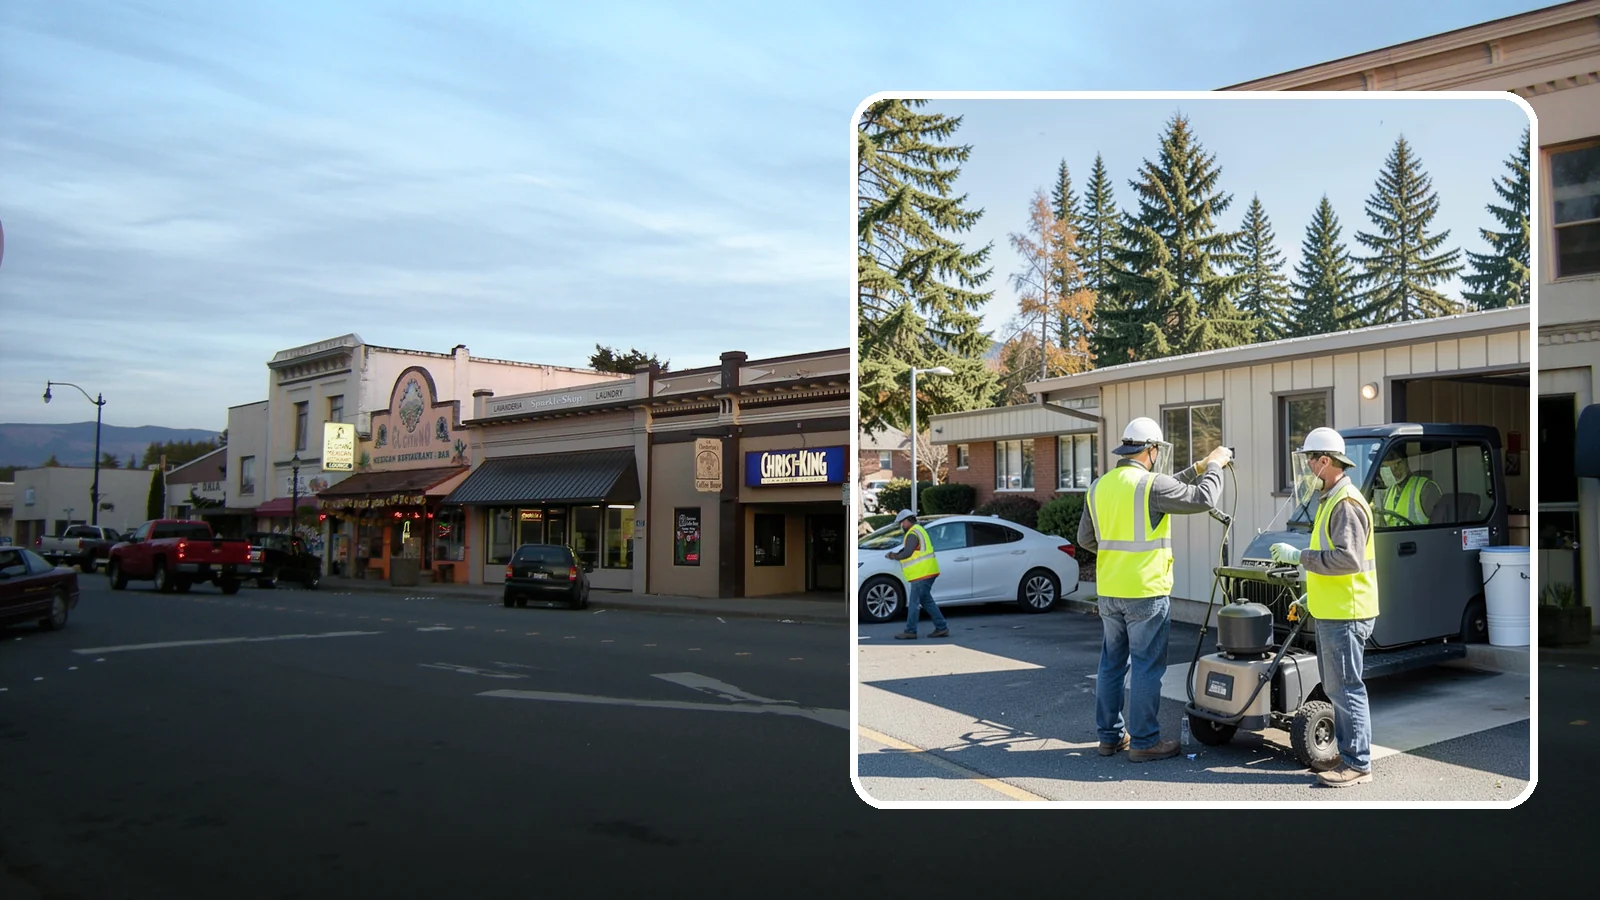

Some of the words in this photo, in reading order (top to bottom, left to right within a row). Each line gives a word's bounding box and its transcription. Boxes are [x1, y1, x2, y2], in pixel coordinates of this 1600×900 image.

[494, 402, 523, 412] LAVANDERIA
[531, 398, 560, 409] Sparkle
[561, 394, 582, 405] Shop
[596, 389, 624, 400] LAUNDRY
[374, 454, 396, 464] MEXICAN
[398, 451, 433, 462] RESTAURANT
[438, 450, 450, 459] BAR
[761, 452, 797, 477] CHRIST
[799, 450, 827, 476] KING
